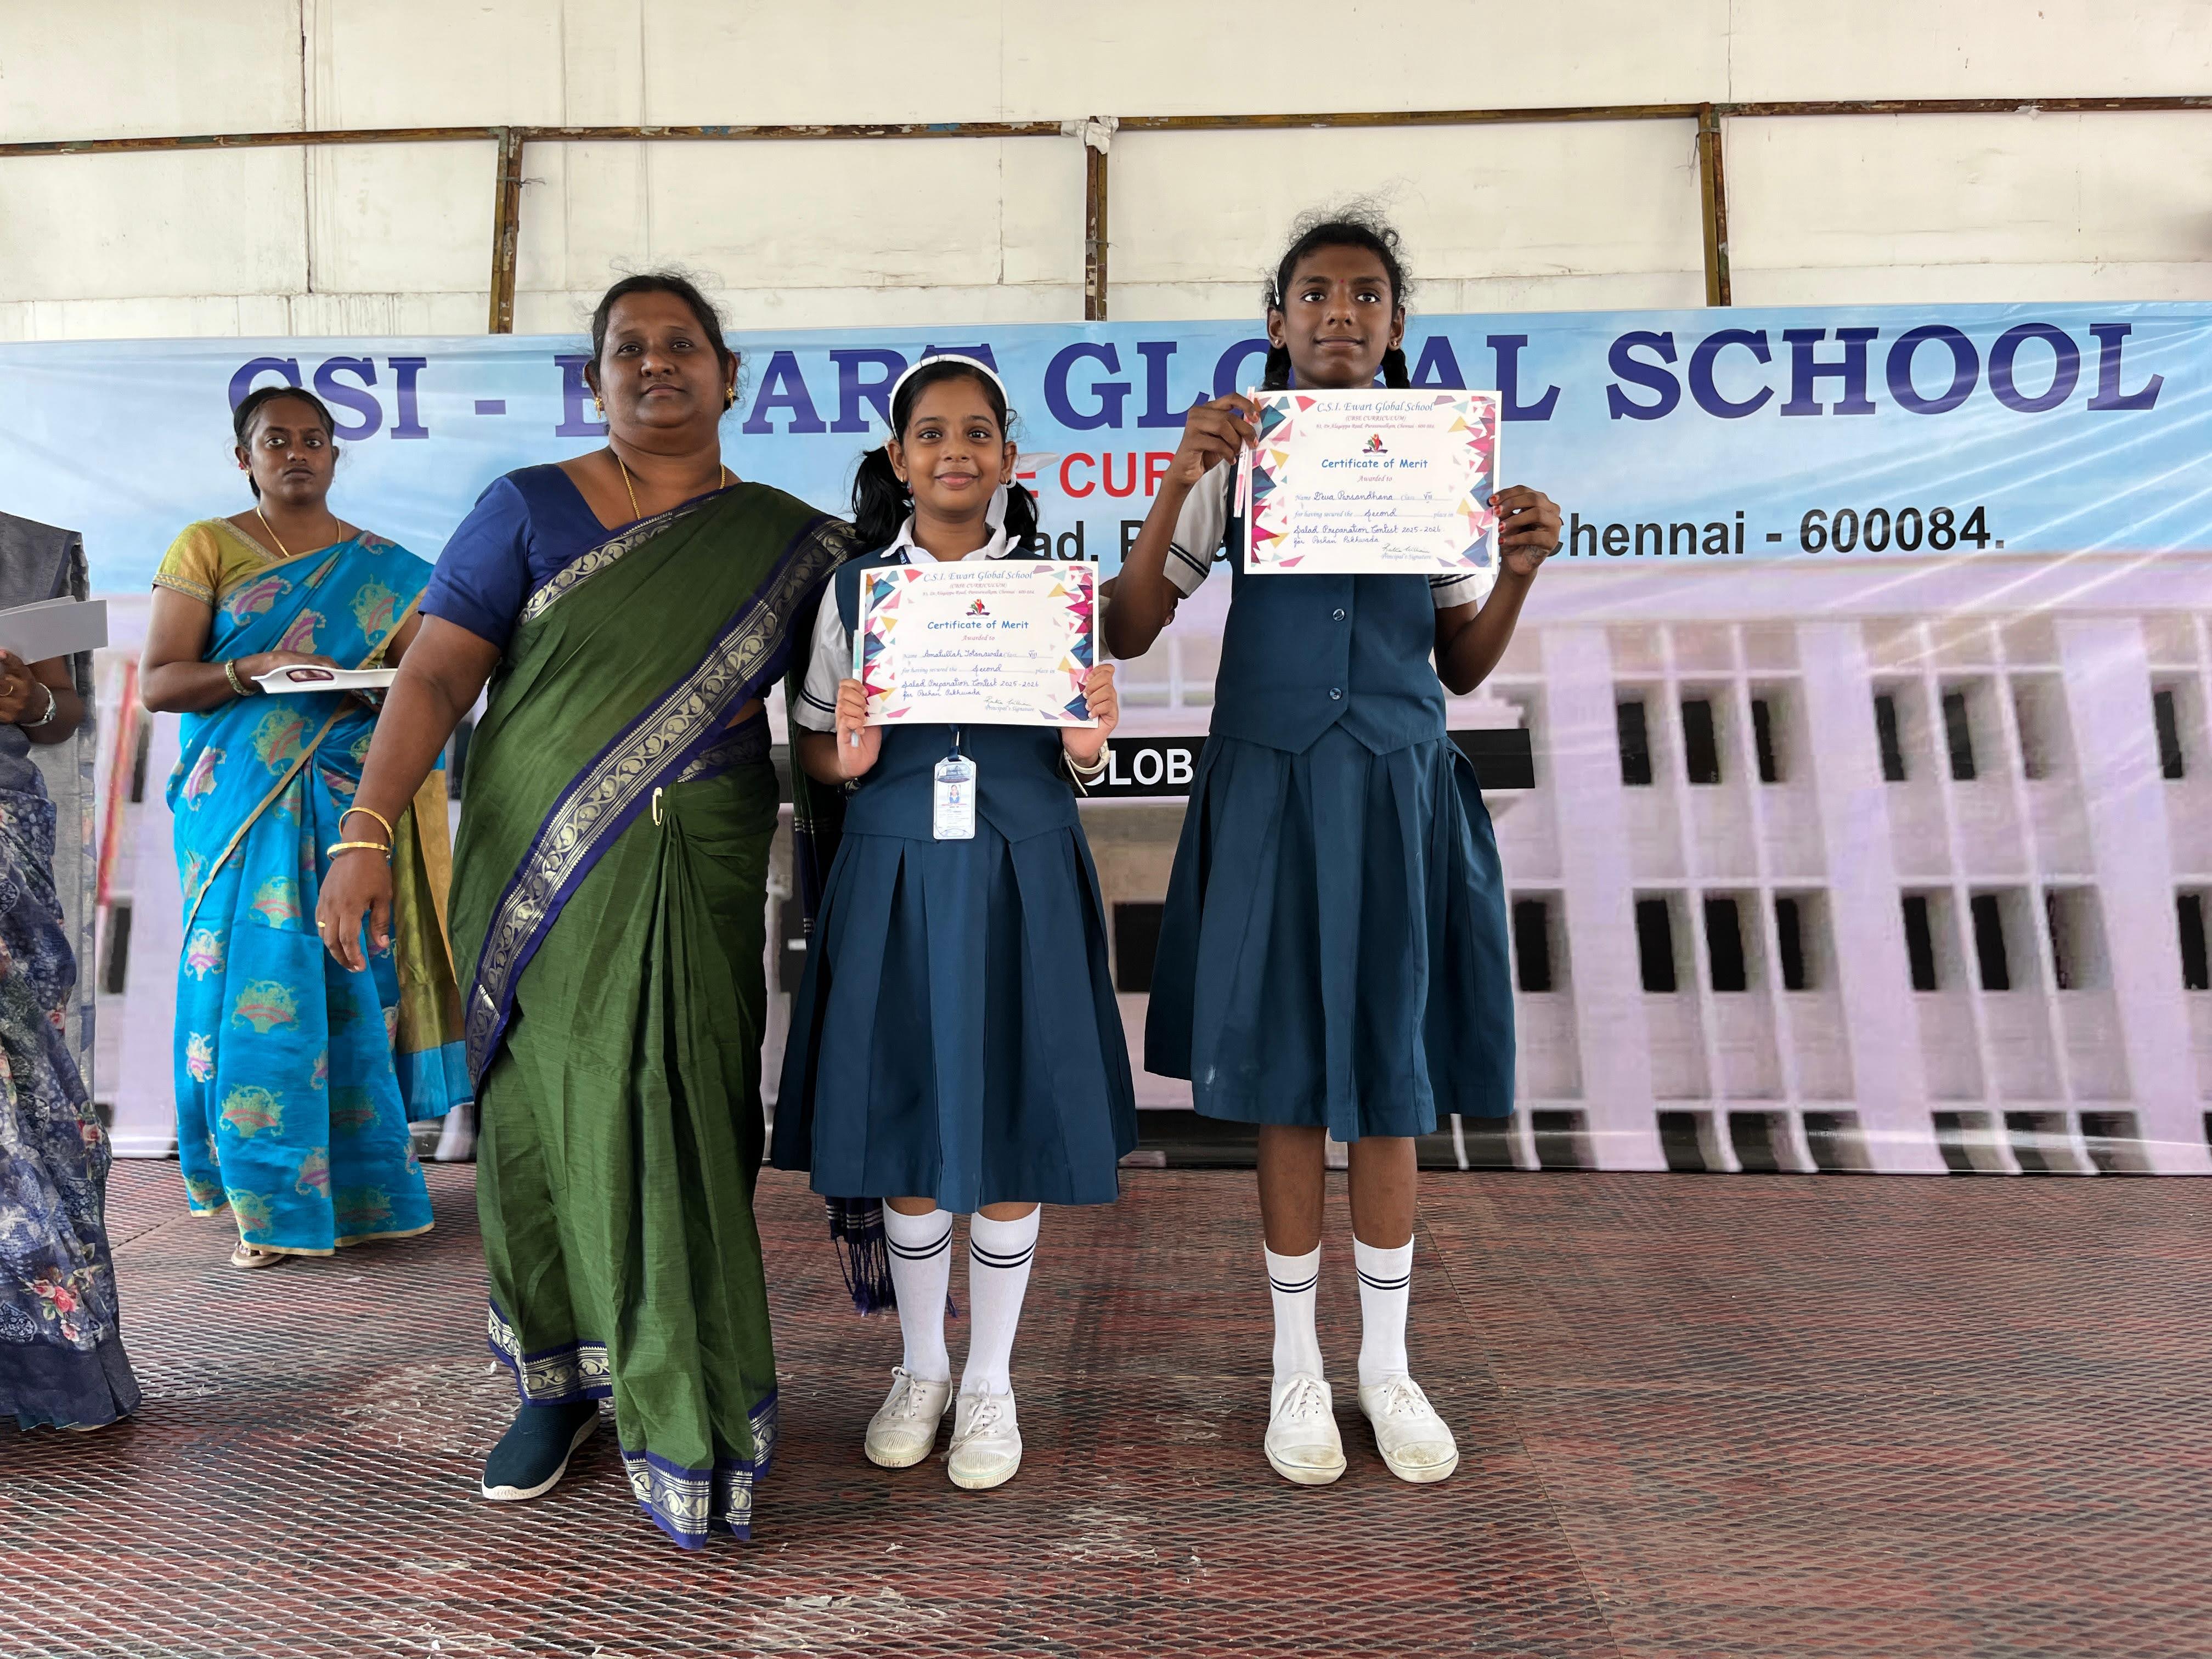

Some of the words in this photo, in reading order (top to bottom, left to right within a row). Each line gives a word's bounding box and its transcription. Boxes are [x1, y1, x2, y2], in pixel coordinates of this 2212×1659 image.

[228, 357, 429, 441] CSI
[475, 400, 506, 415] -
[1606, 323, 2165, 421] SCHOOL
[1317, 403, 1341, 413] C.S.I.
[1344, 402, 1372, 411] Ewart
[1375, 402, 1403, 413] Global
[1405, 401, 1435, 411] School
[1322, 458, 1379, 468] Certificate
[1384, 458, 1395, 468] of
[1400, 458, 1428, 468] Merit
[1766, 533, 1782, 542] -
[1800, 505, 2004, 554] 600084.
[923, 573, 946, 582] C.S.I.
[948, 571, 975, 580] Ewart
[978, 571, 1004, 582] Global
[1006, 569, 1033, 579] School
[927, 620, 981, 629] Certificate
[986, 620, 998, 629] of
[1001, 620, 1029, 629] Merit
